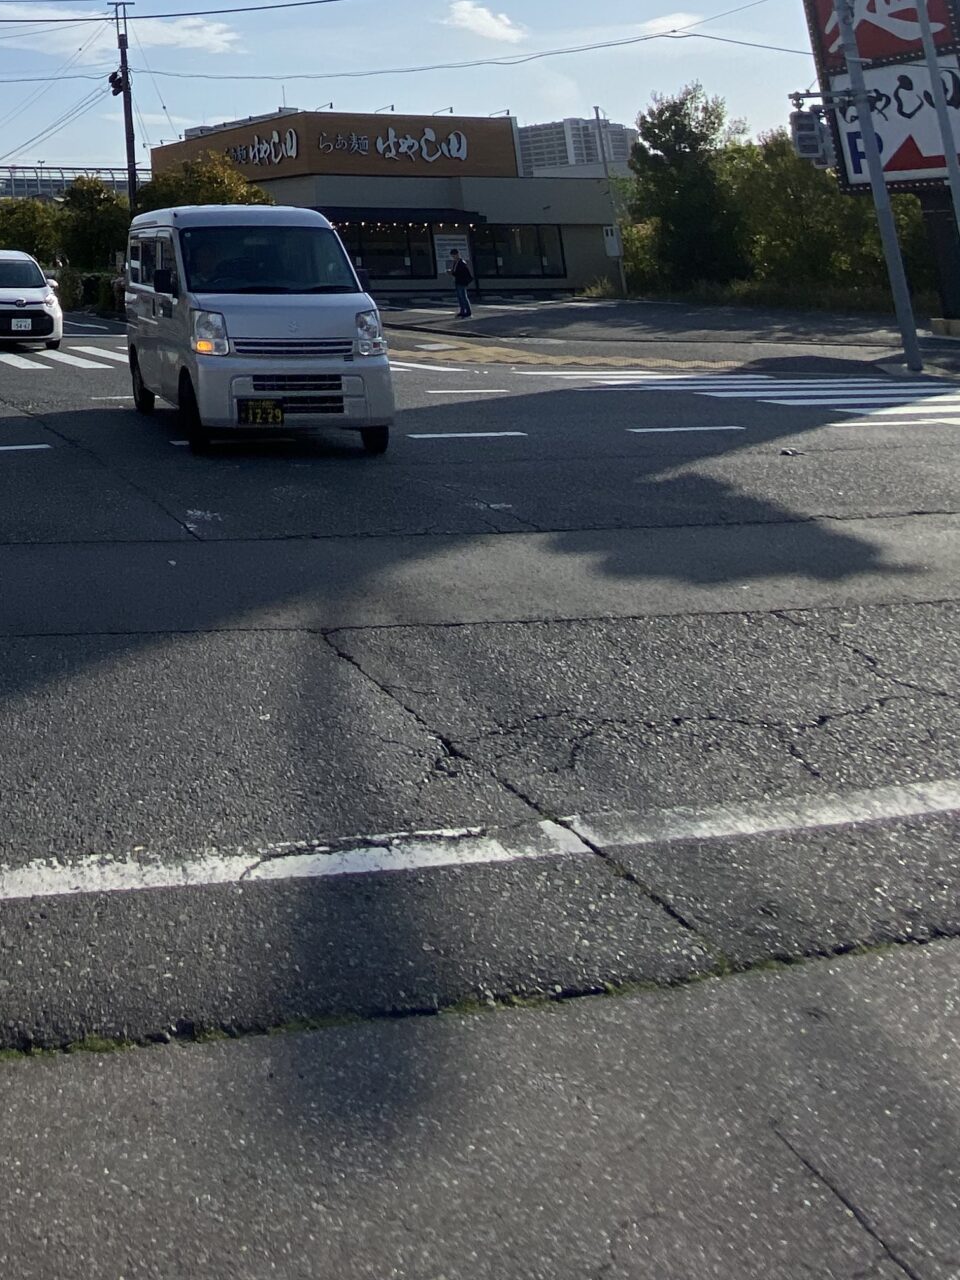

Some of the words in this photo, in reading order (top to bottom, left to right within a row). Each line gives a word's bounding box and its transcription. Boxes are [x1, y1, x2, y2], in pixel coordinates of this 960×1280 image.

[377, 127, 468, 162] はやし田
[847, 130, 884, 174] P
